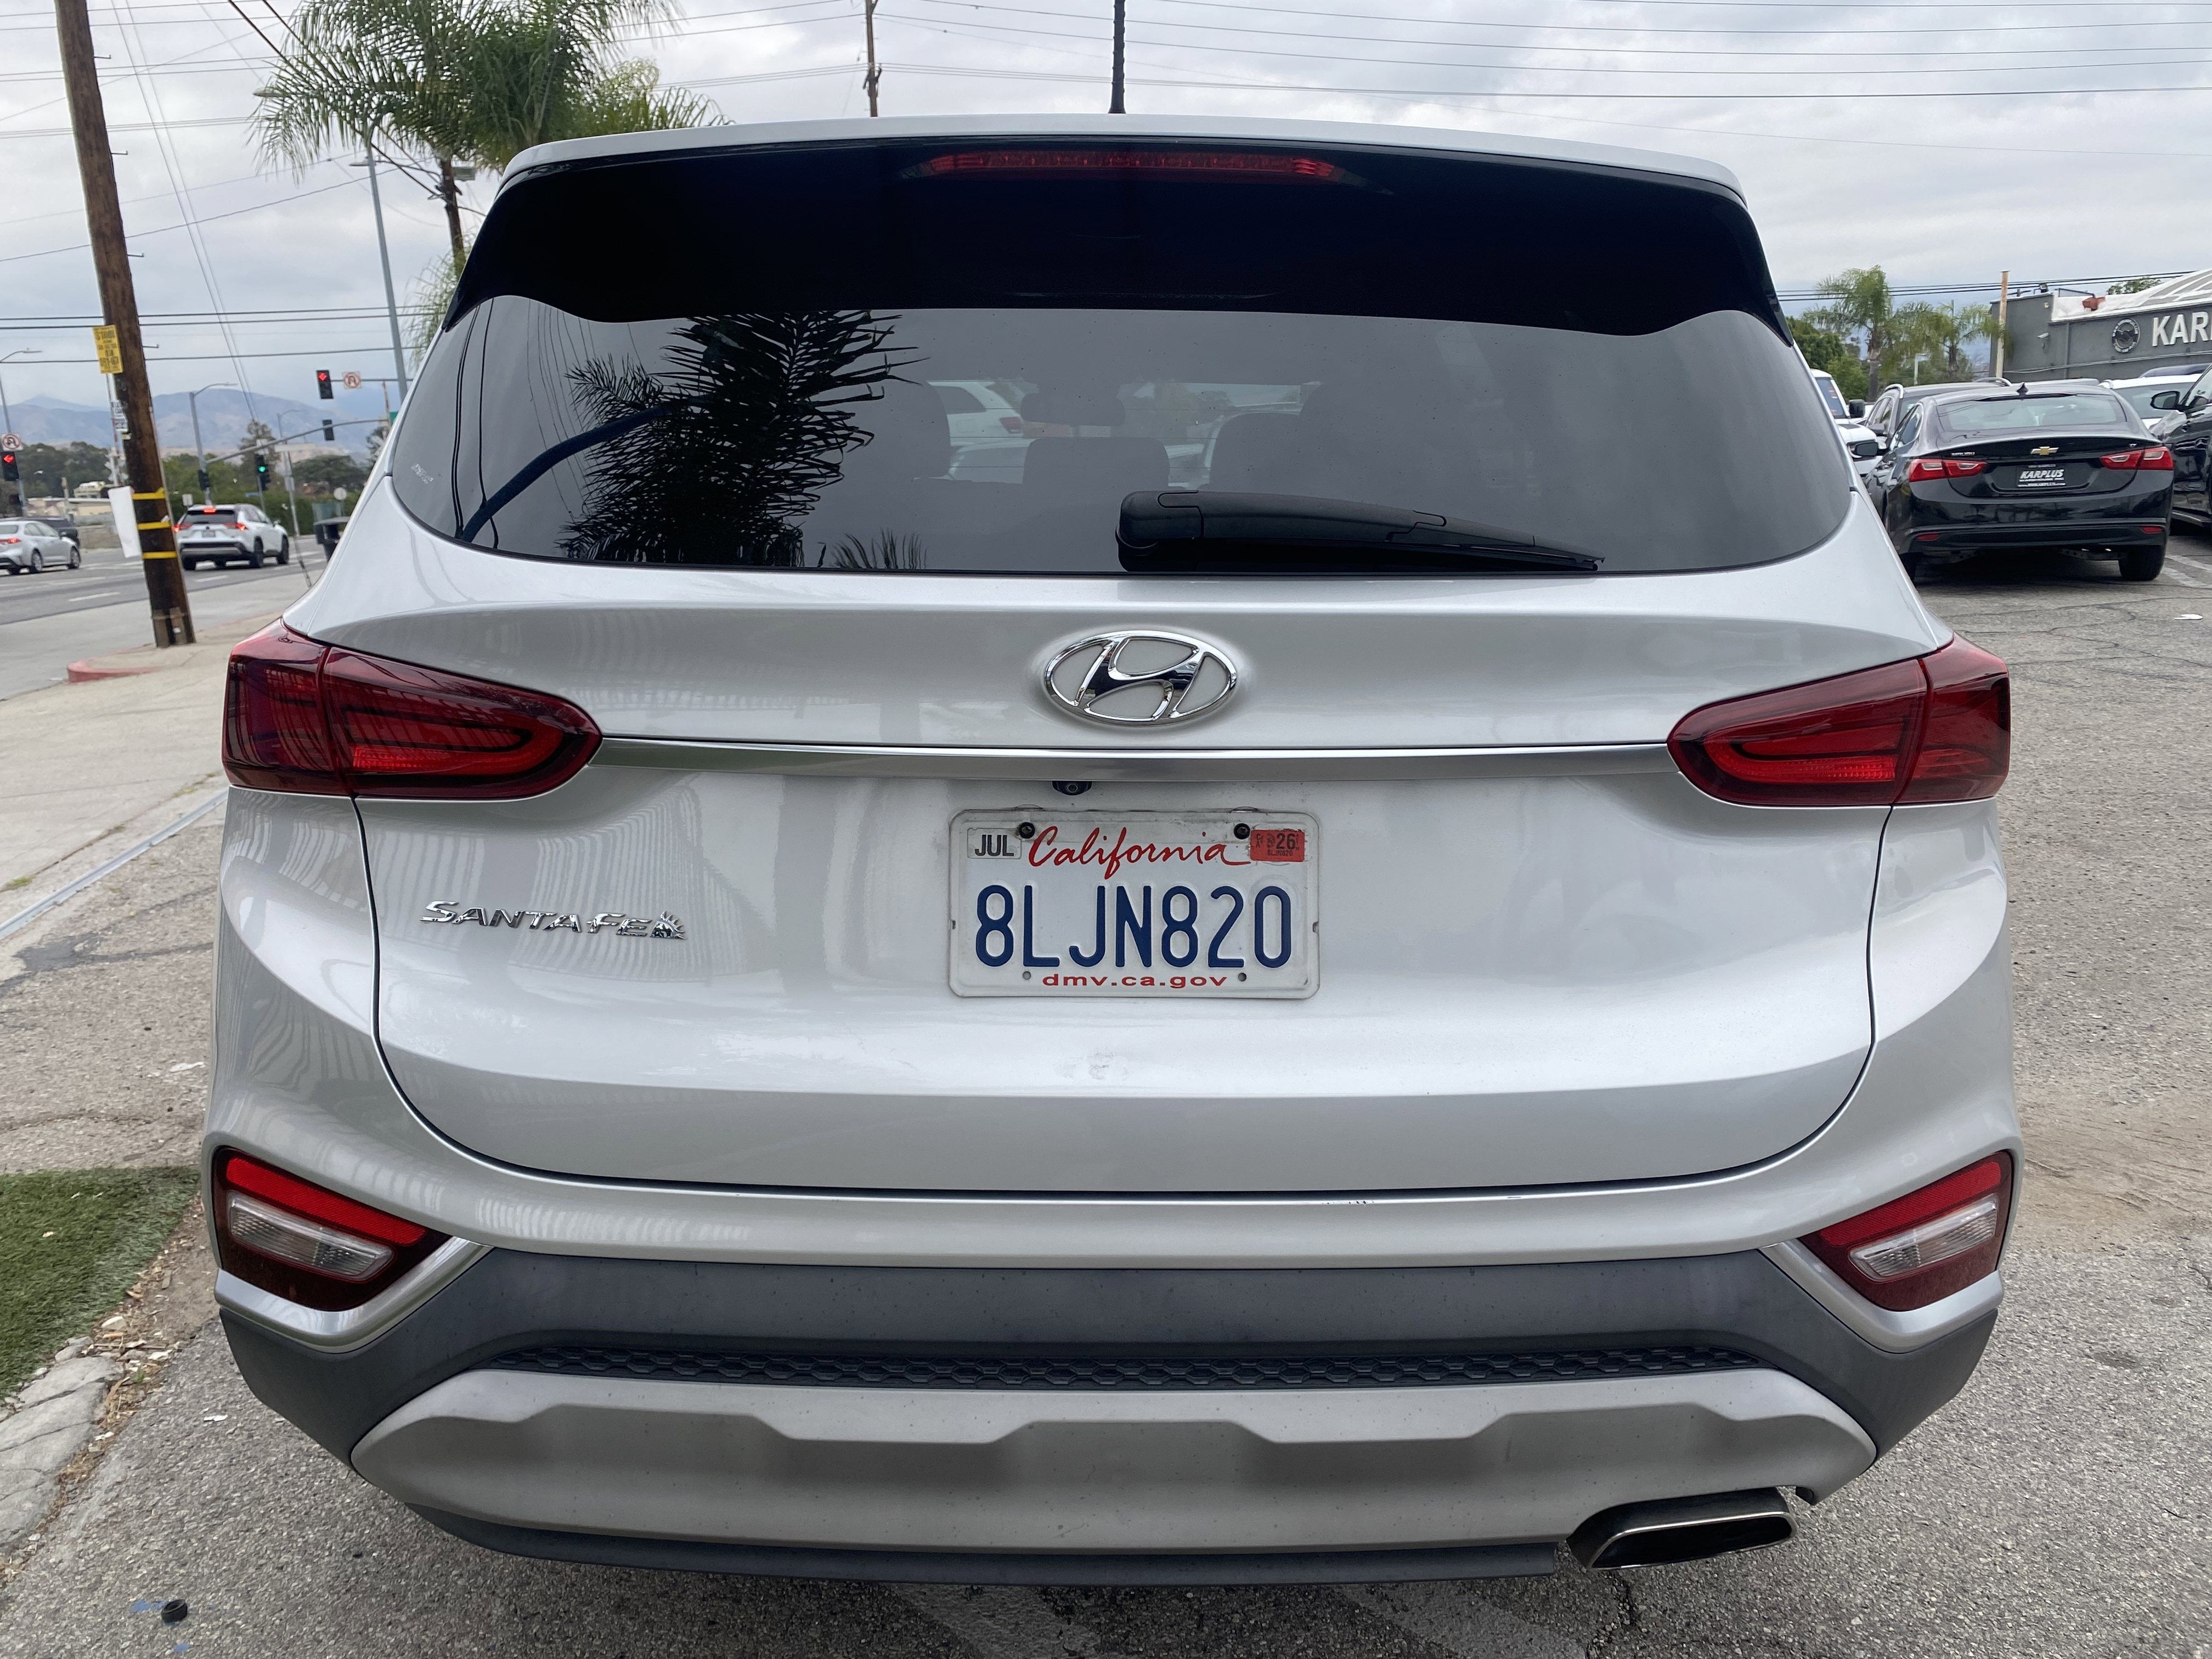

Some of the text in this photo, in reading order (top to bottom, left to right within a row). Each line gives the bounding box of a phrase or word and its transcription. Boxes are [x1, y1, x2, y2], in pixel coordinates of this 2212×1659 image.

[2152, 311, 2212, 347] KAR
[2020, 470, 2064, 479] KARPLUS
[974, 834, 1017, 857] JUL
[1028, 826, 1251, 879] California
[1276, 833, 1295, 850] 26
[420, 900, 653, 937] SANTA FE
[975, 884, 1291, 968] 8LJN820
[1042, 973, 1228, 989] dmv.ca.gov
